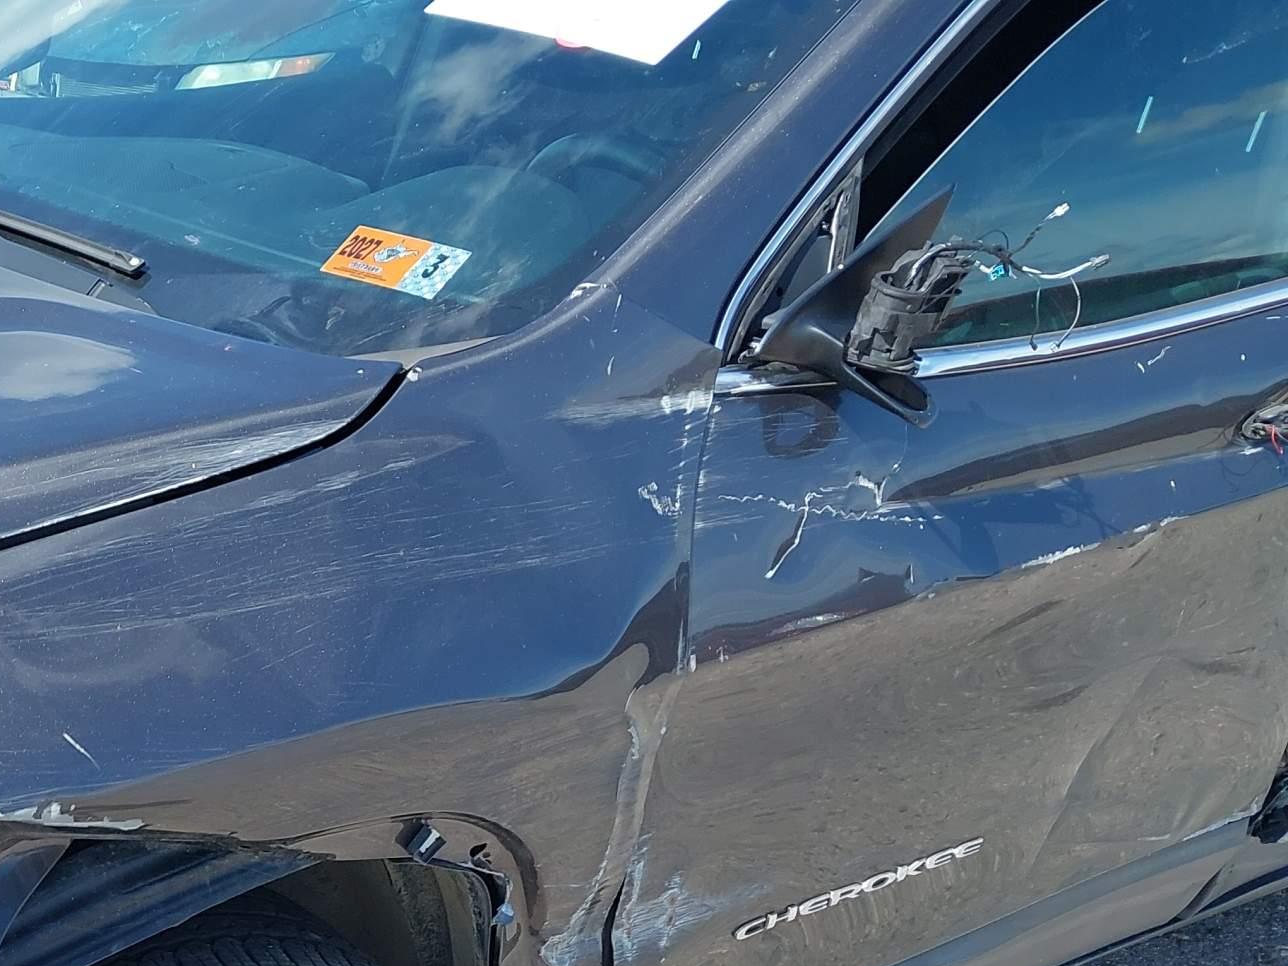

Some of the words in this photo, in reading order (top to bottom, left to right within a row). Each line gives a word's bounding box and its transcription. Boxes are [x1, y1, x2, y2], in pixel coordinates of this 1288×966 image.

[338, 234, 383, 260] 2027
[421, 253, 449, 278] 3
[734, 837, 985, 940] CHEROKEE
